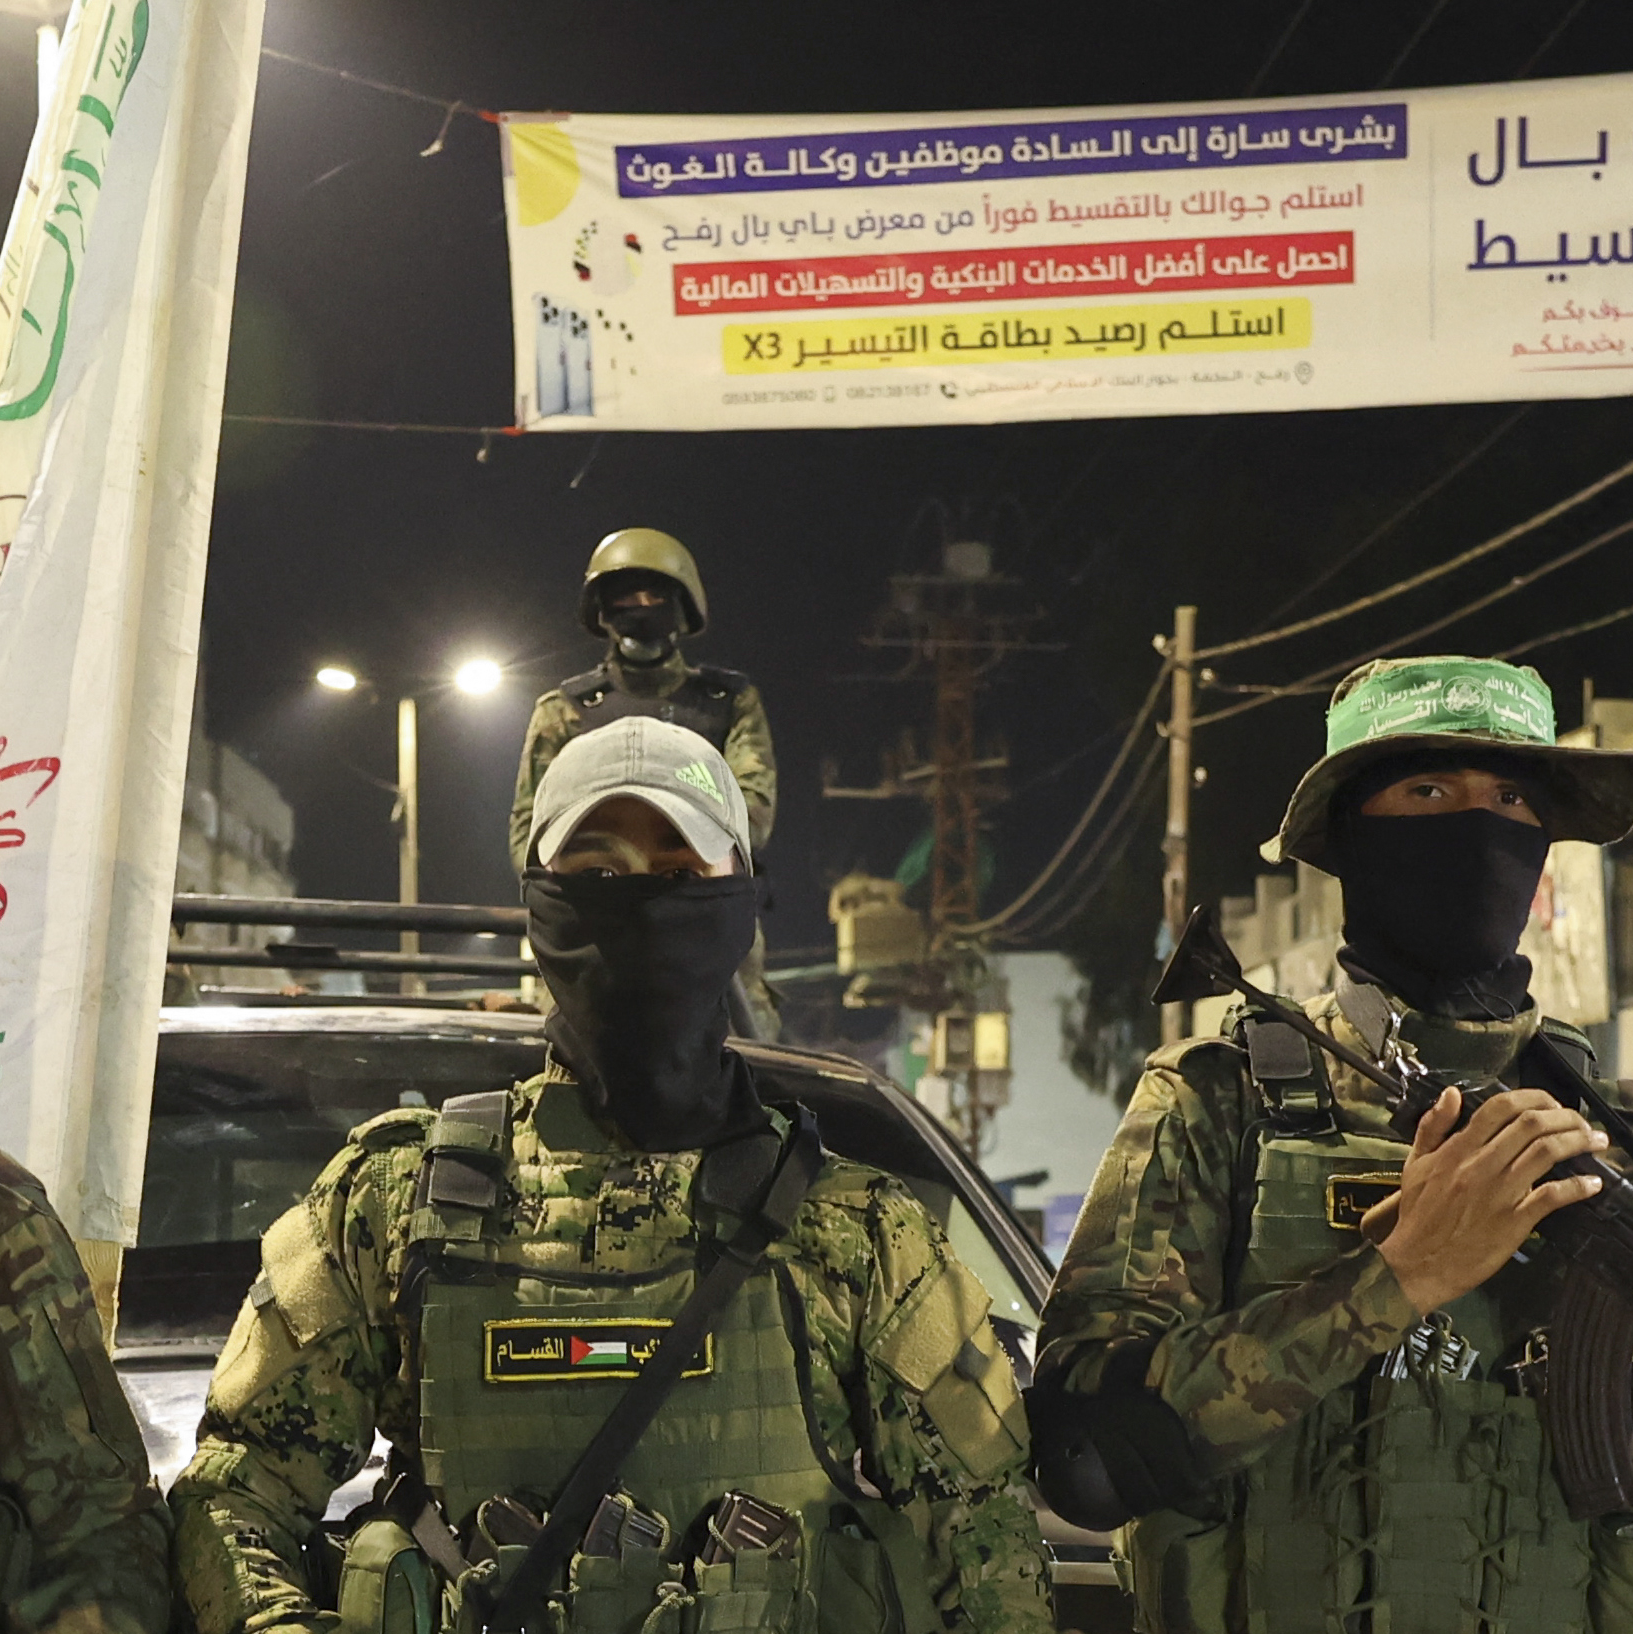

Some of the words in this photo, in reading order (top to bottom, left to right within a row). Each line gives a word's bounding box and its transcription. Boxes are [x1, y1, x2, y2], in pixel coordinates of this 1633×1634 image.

[1011, 130, 1132, 161] السادة
[1141, 126, 1198, 162] إلى
[1207, 126, 1290, 160] سارة
[1298, 114, 1396, 156] بشرى
[1468, 115, 1609, 187] بال
[626, 152, 737, 190] الغوث
[743, 147, 858, 181] وكالة
[865, 139, 1004, 179] موظفين
[1045, 193, 1172, 229] بالتقسيط
[1180, 189, 1271, 221] جوالك
[1279, 184, 1364, 220] استلم
[662, 217, 722, 252] رفح
[731, 214, 769, 246] بال
[778, 211, 836, 244] باي
[844, 208, 926, 240] معرض
[935, 209, 975, 235] من
[930, 259, 1015, 296] البنكية
[1021, 253, 1128, 286] الخدمات
[1133, 242, 1206, 287] أفضل
[1212, 249, 1271, 276] على
[1276, 244, 1348, 280] احصل
[680, 272, 768, 308] المالية
[774, 265, 925, 302] والتسهيلات
[1159, 306, 1285, 350] استلم
[1542, 299, 1586, 324] بكم
[743, 331, 782, 362] X3
[793, 325, 928, 368] التيسير
[941, 320, 1052, 355] بطاقة
[1063, 321, 1146, 352] رصيد
[496, 1337, 564, 1366] القسام
